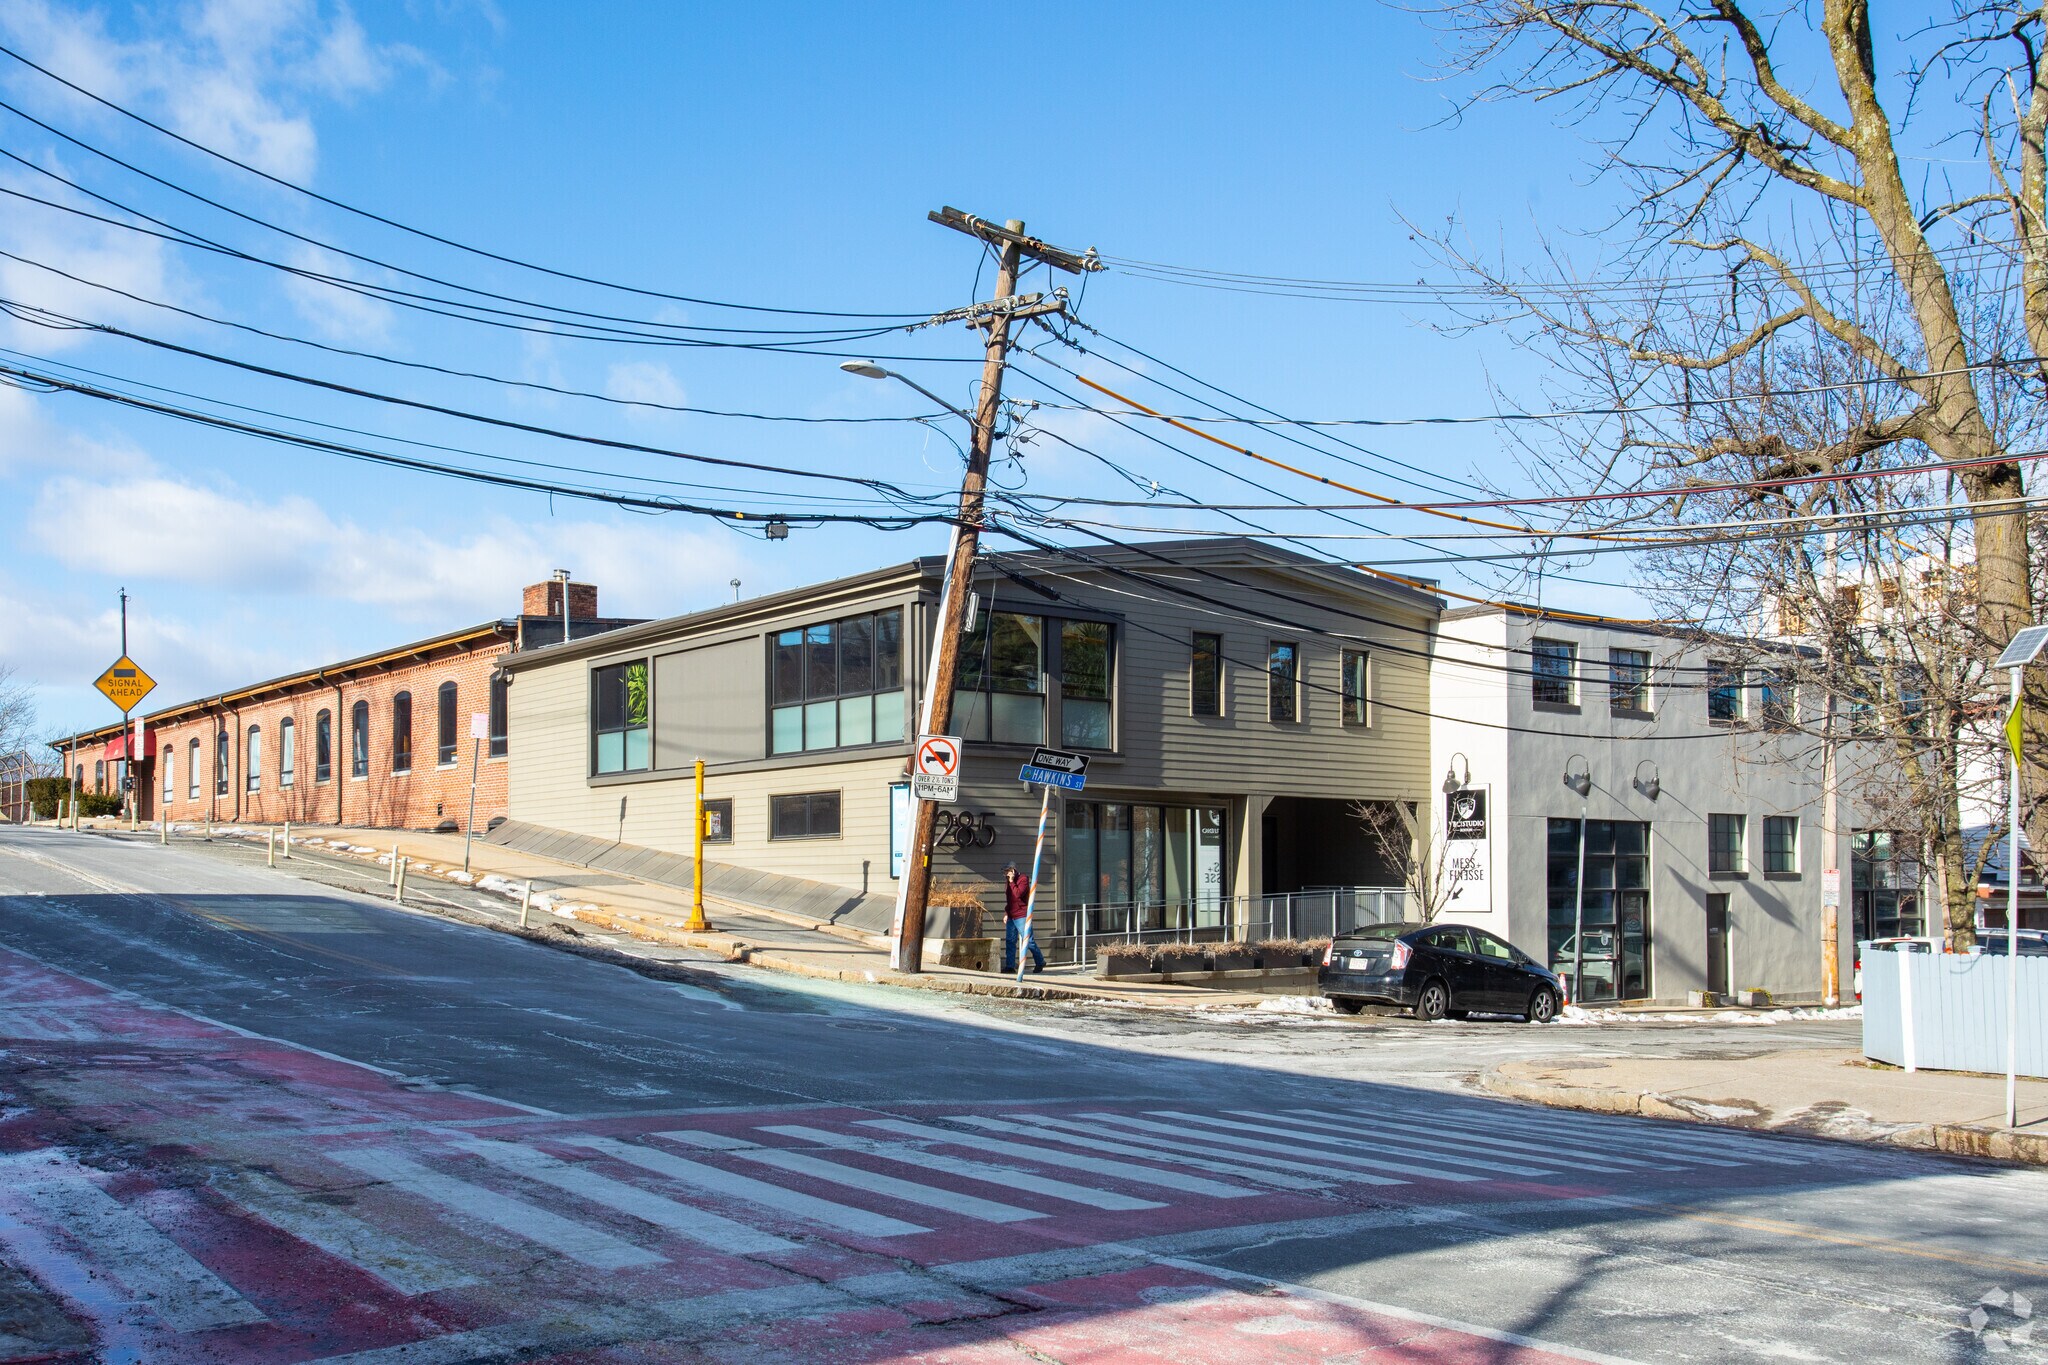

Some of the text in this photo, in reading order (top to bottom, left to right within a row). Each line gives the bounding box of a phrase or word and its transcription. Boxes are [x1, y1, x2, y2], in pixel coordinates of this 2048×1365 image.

[108, 679, 143, 687] SIGNAL
[109, 688, 143, 696] AHEAD
[1037, 754, 1072, 767] ONE WAY
[917, 775, 931, 783] OVER
[1031, 768, 1073, 787] HAWKINS
[933, 810, 996, 848] 285
